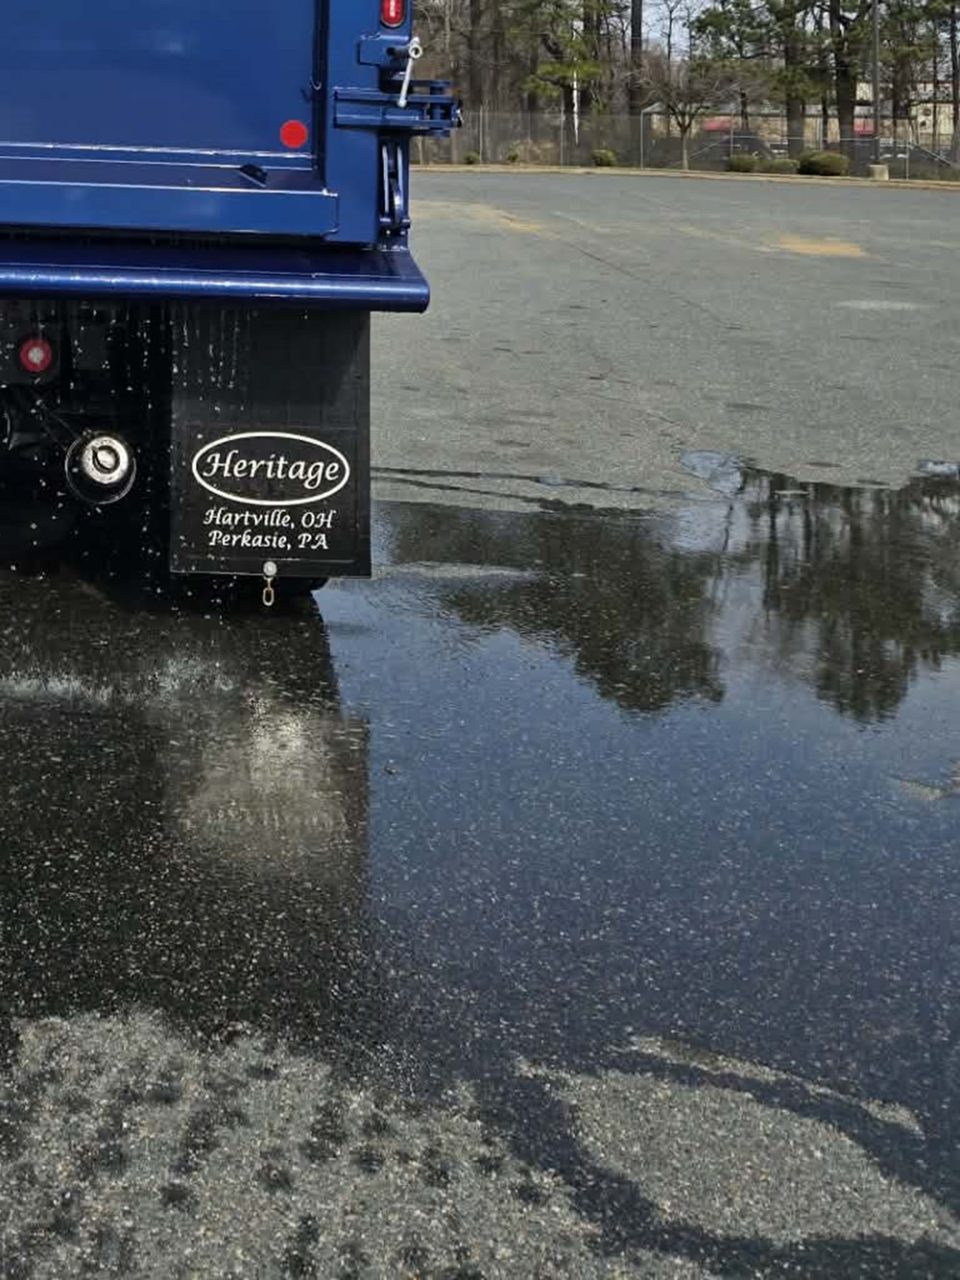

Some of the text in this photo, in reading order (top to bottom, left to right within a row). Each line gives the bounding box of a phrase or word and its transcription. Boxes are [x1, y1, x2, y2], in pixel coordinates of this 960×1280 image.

[203, 450, 340, 489] Heritage
[203, 508, 336, 529] Hartville, OH
[208, 530, 329, 550] Perkasie, PA
